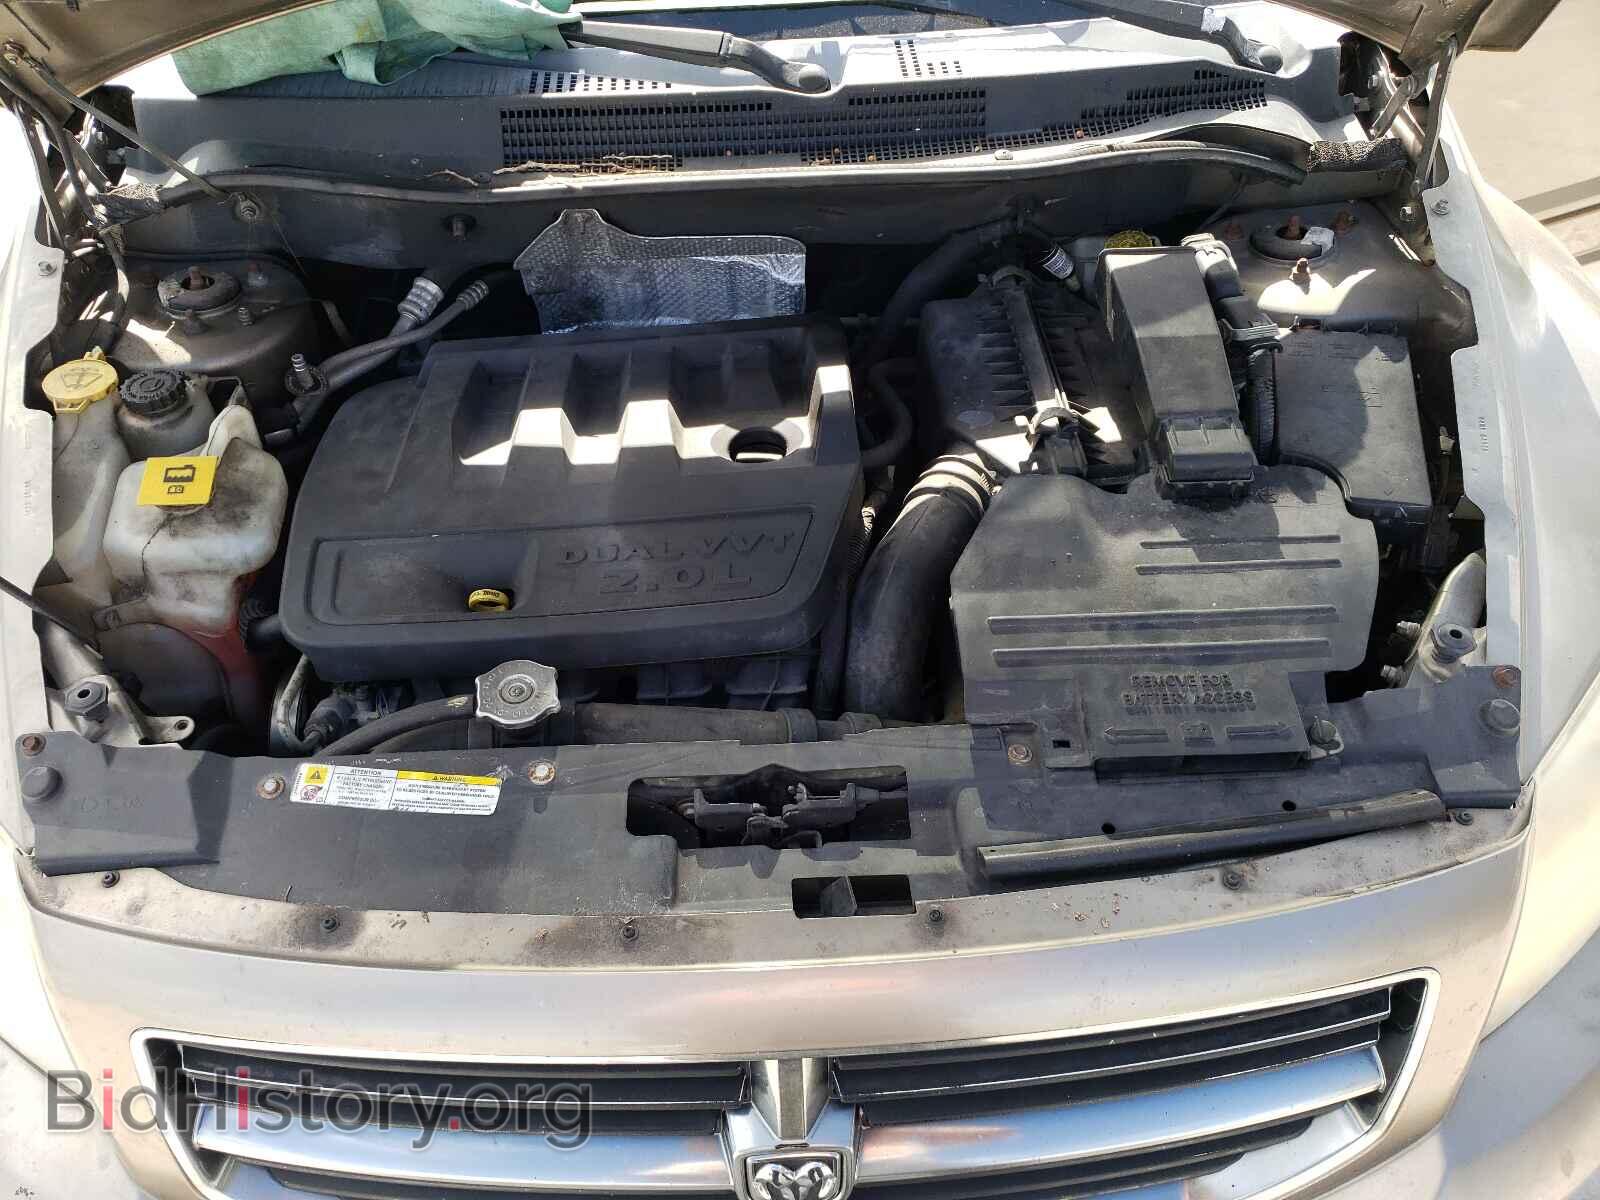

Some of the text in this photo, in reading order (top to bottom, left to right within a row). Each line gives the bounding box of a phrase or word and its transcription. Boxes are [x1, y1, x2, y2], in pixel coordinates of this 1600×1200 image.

[560, 530, 794, 565] DUAL VVT
[600, 562, 752, 594] 2.0L
[1130, 673, 1232, 688] REMOVE FOR
[1122, 690, 1255, 705] BATTERY ACCESS
